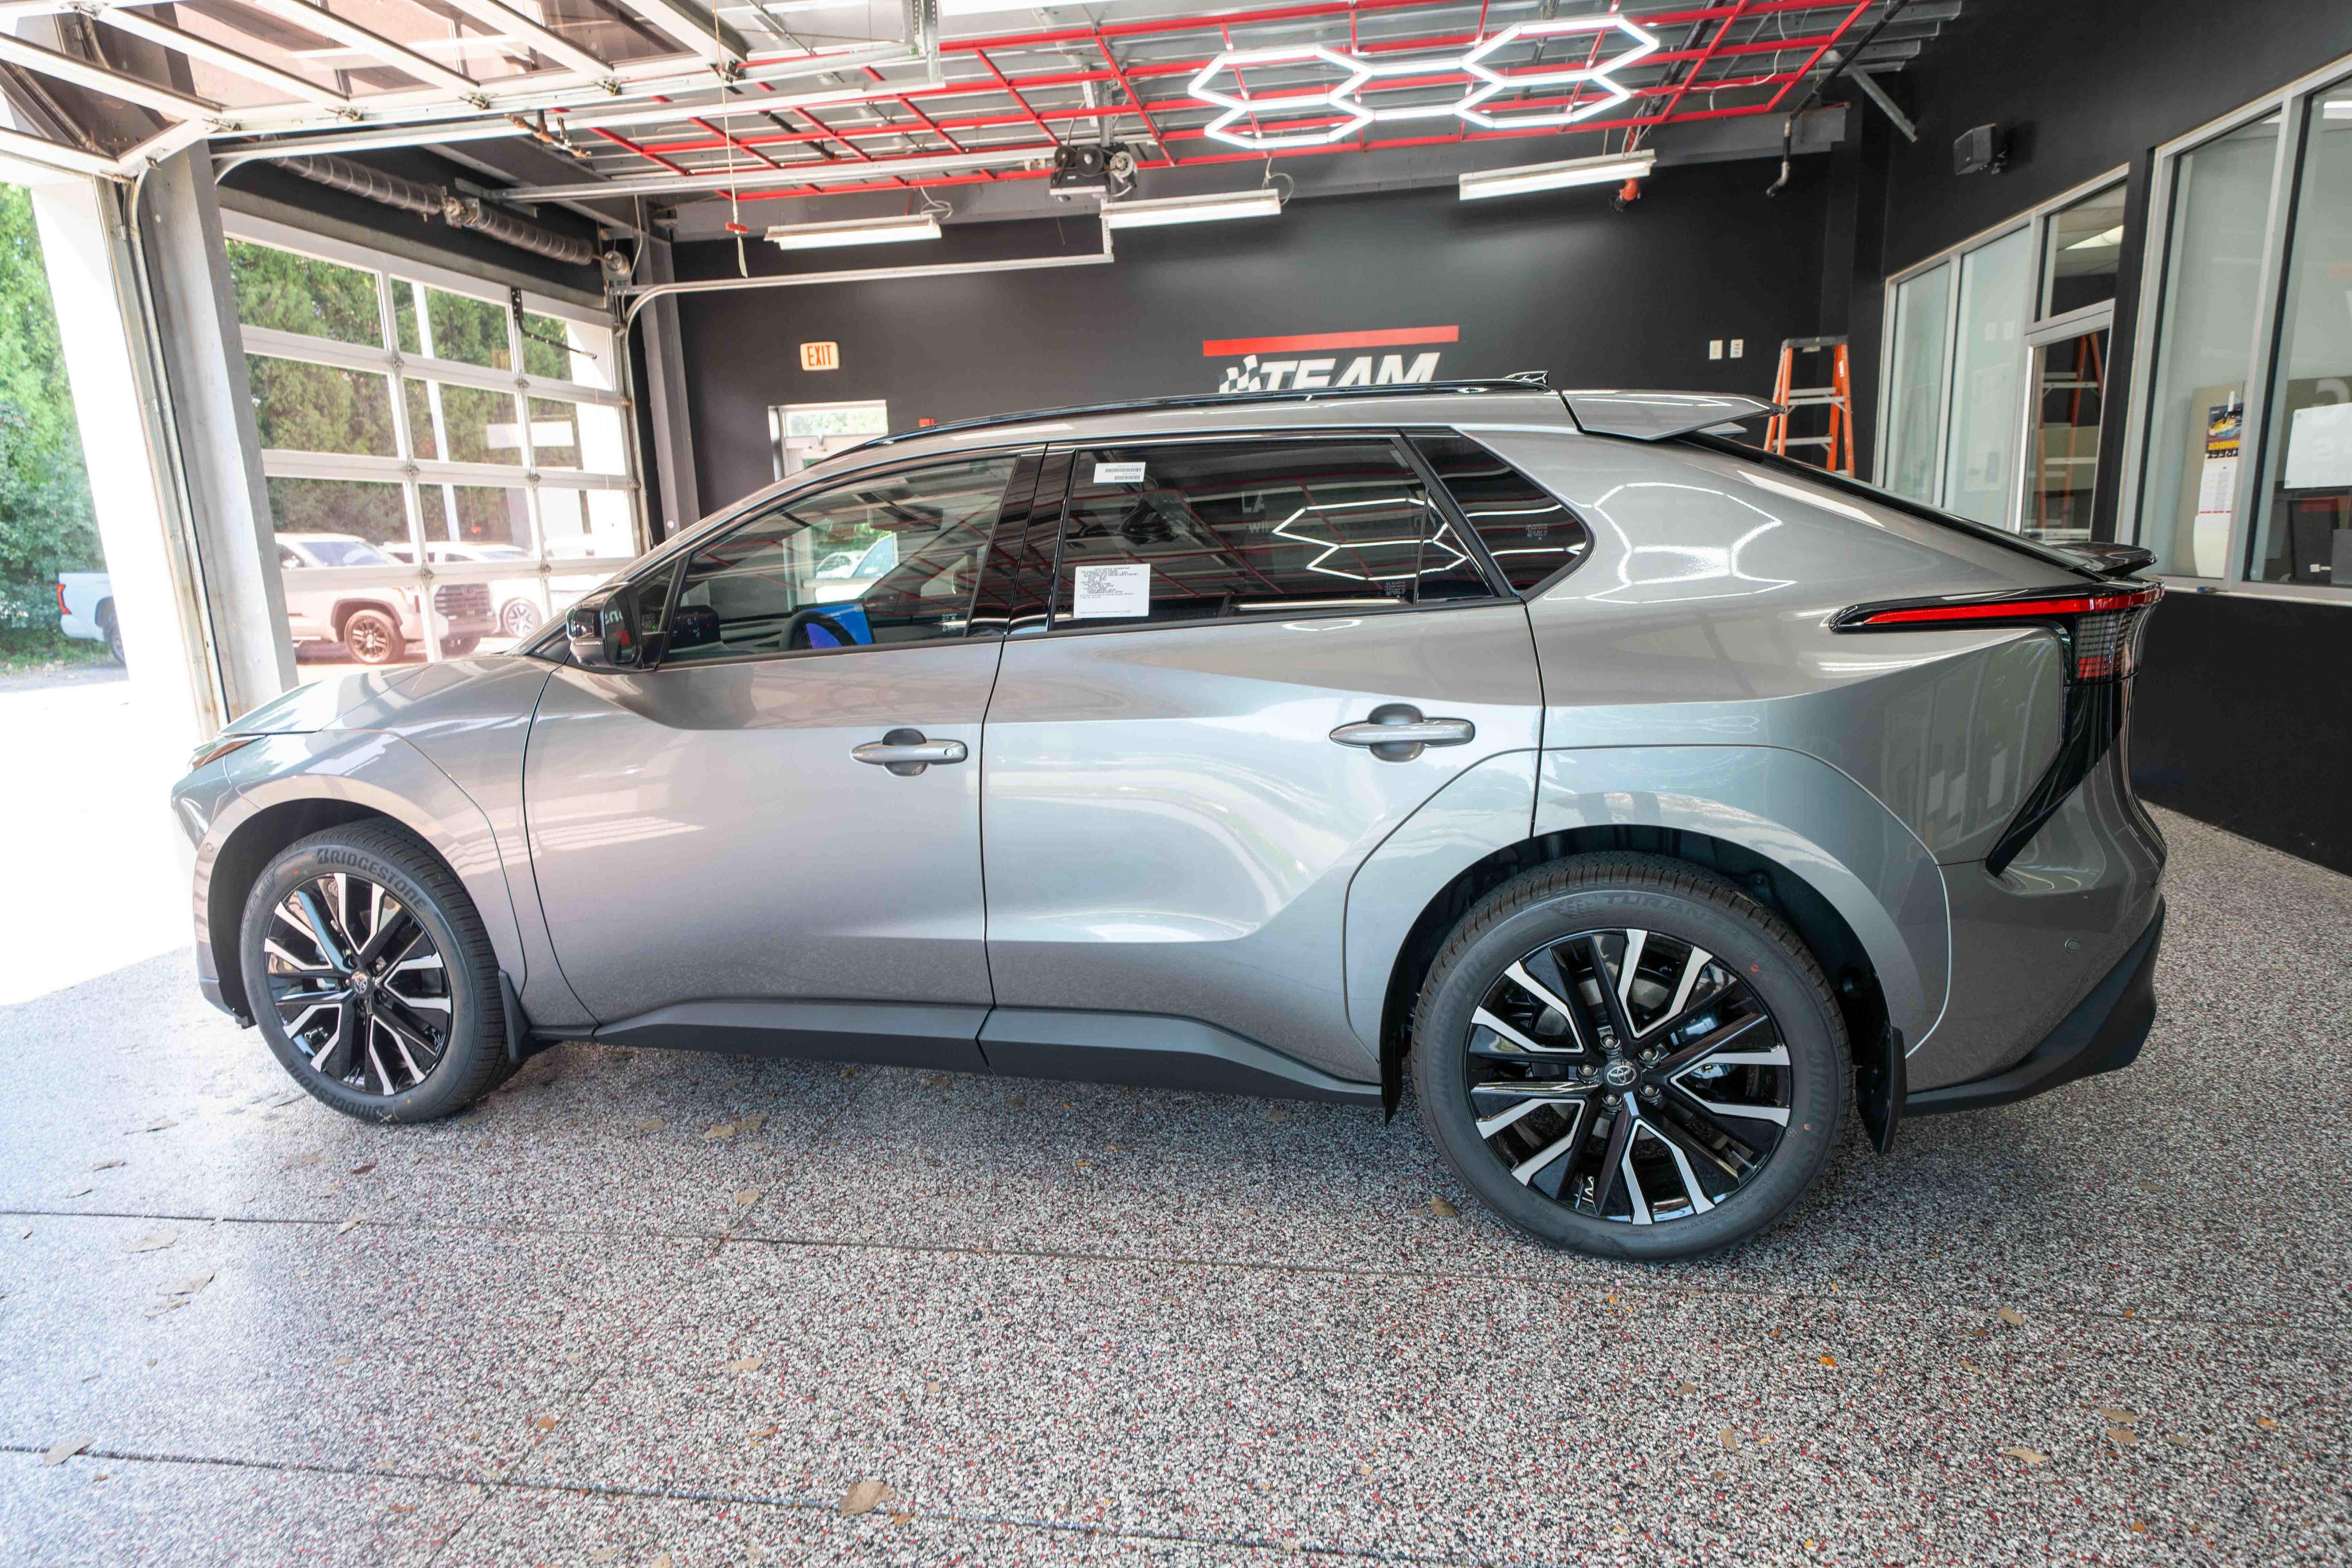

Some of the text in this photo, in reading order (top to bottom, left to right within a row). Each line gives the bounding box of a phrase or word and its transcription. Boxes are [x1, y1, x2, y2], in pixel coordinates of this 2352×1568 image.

[807, 345, 831, 366] EXIT
[1260, 352, 1441, 390] TEAM
[317, 848, 428, 909] BRIDGESTONE
